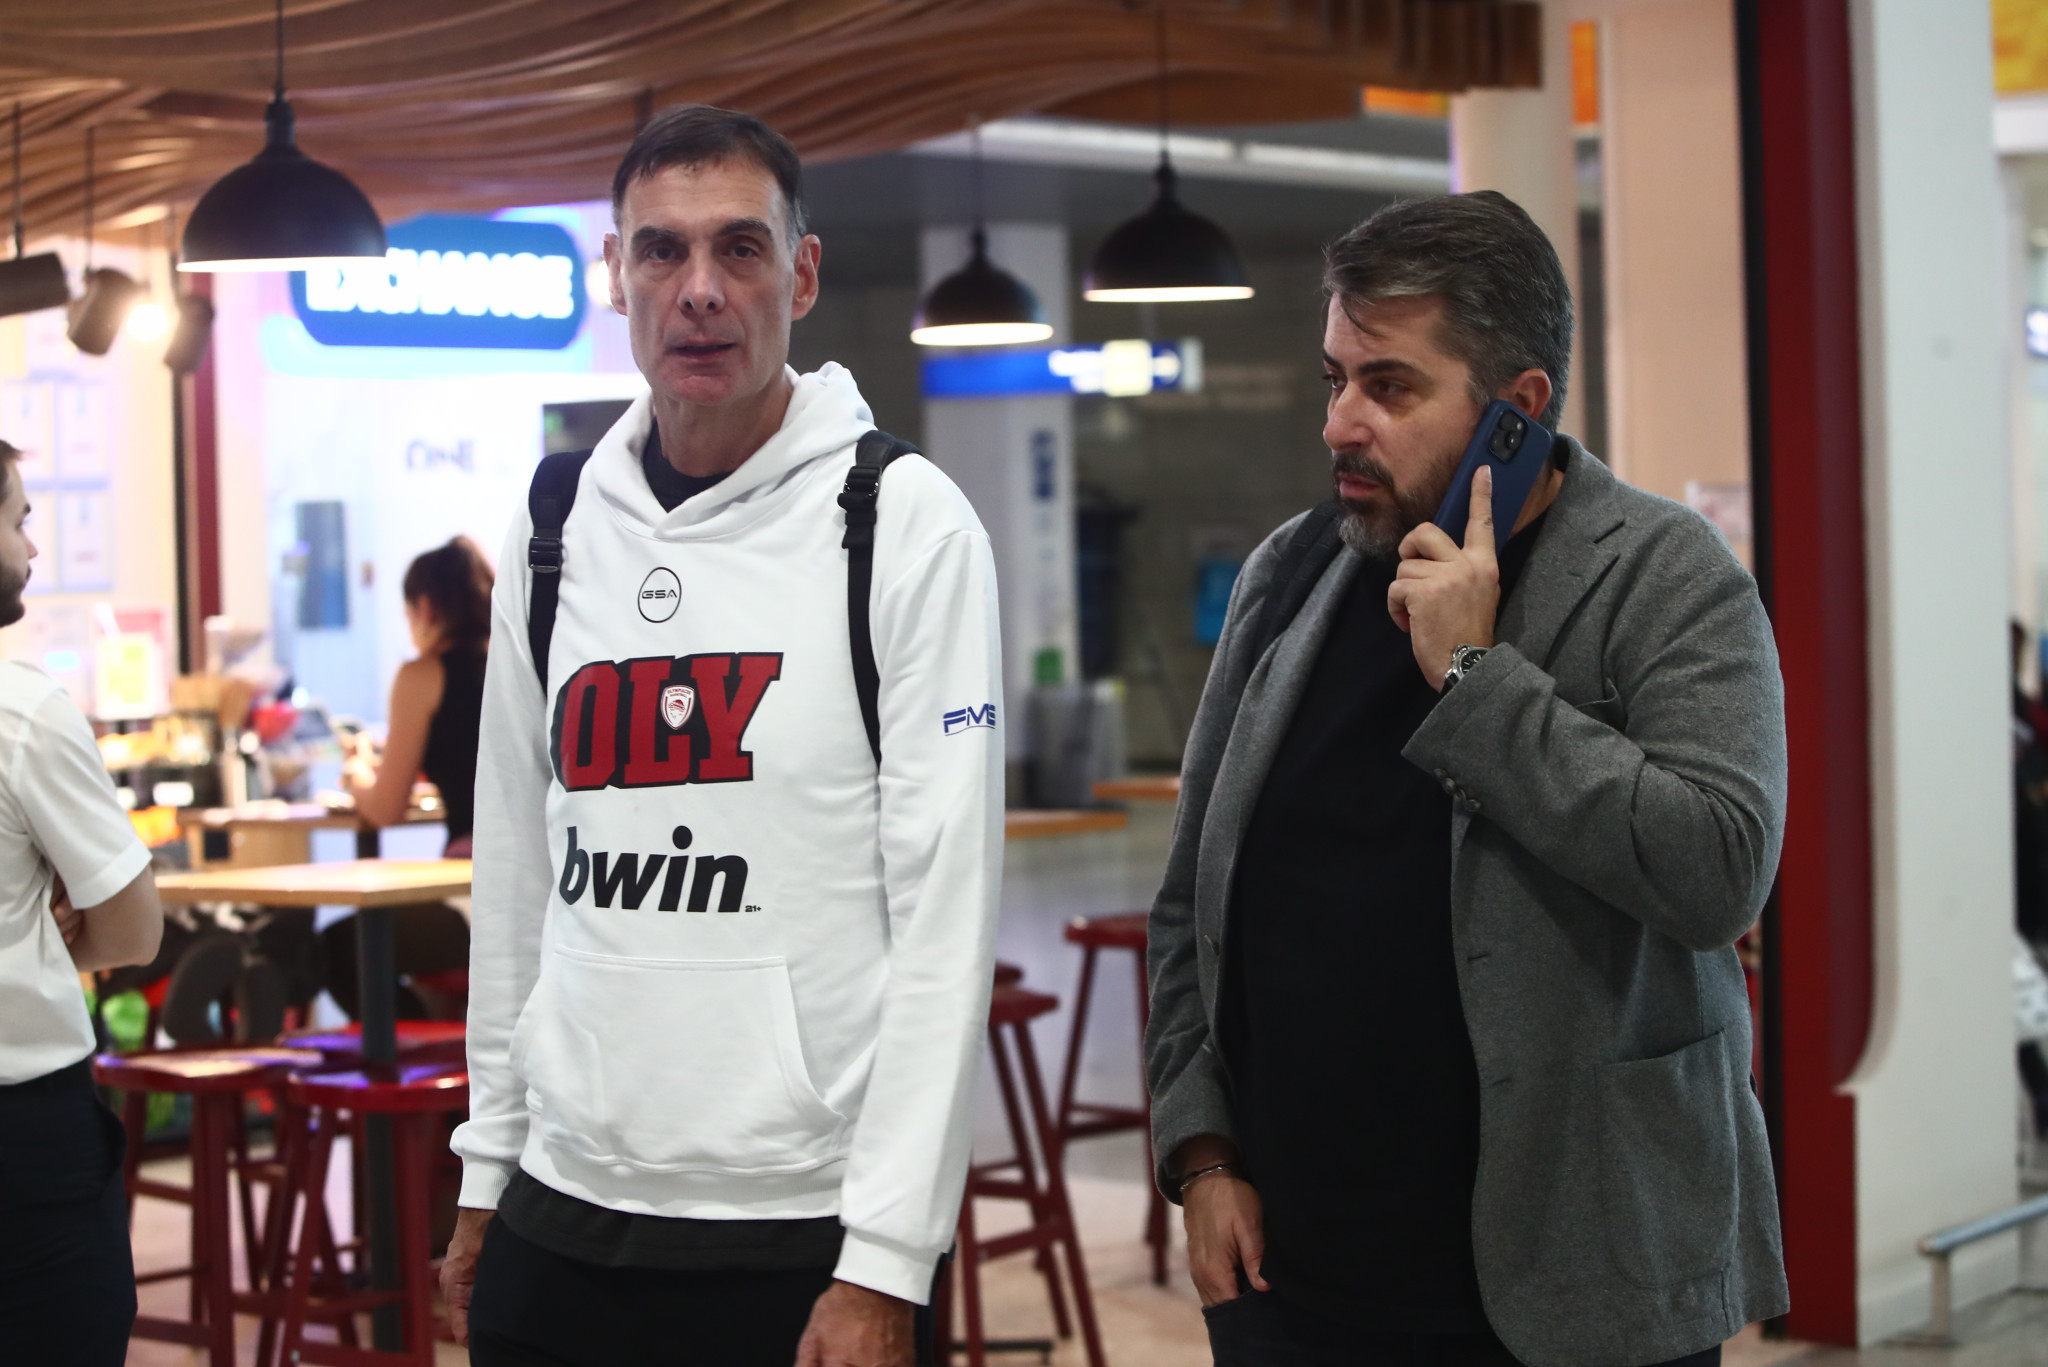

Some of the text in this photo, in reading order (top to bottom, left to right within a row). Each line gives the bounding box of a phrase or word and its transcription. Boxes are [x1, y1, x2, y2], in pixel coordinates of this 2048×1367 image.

[641, 589, 677, 599] GSA
[550, 652, 784, 792] OLY
[559, 825, 748, 913] bwin
[744, 904, 762, 913] 21+
